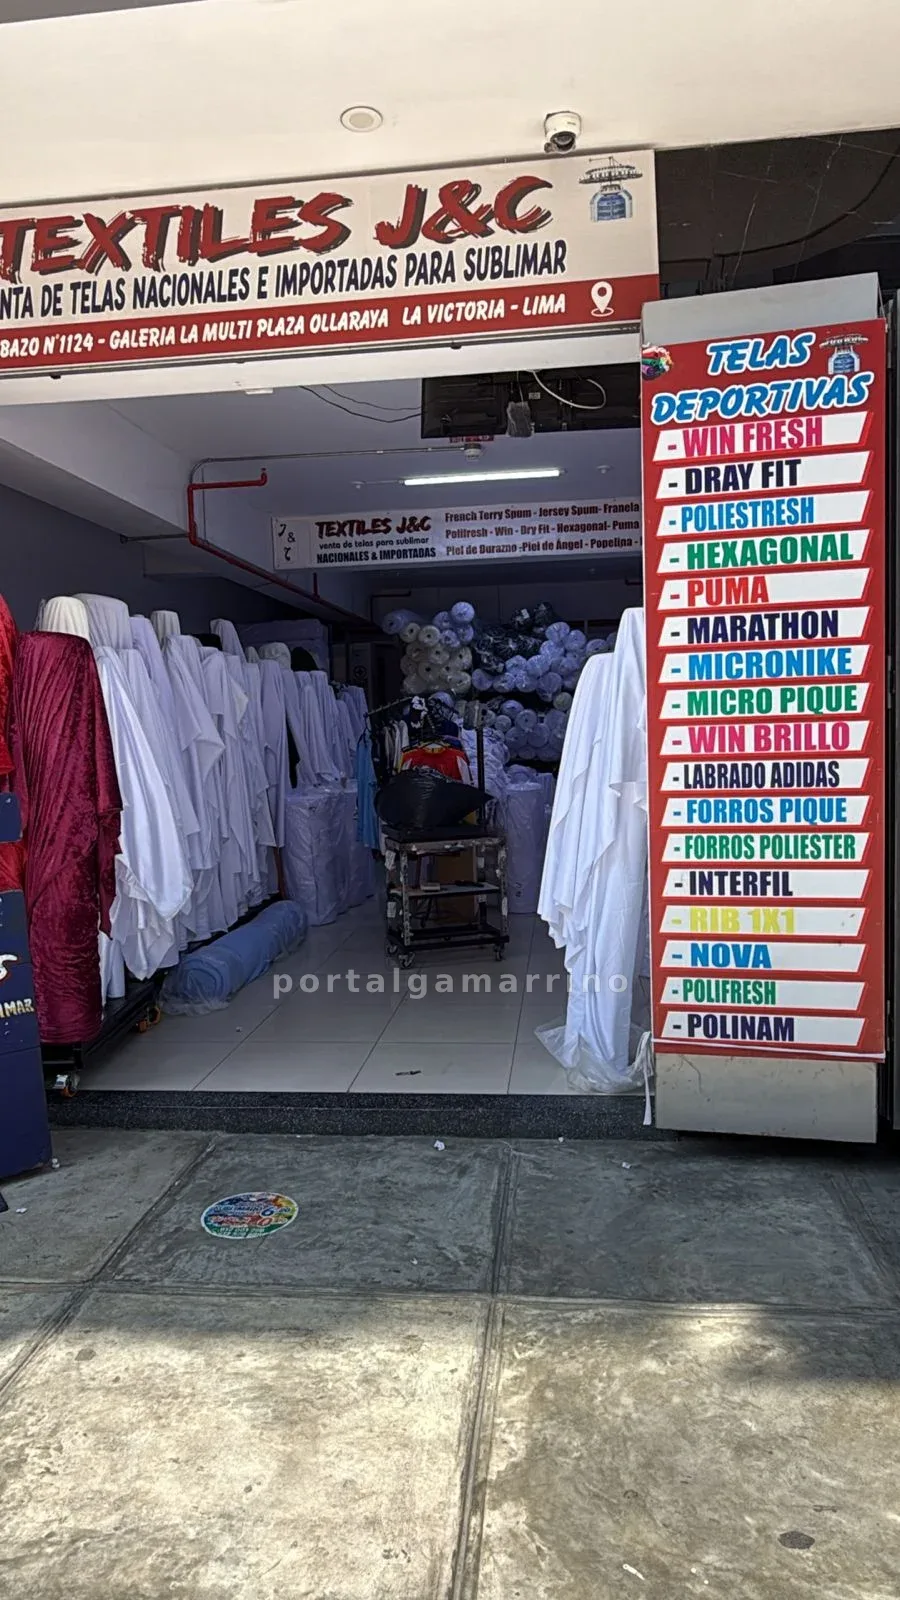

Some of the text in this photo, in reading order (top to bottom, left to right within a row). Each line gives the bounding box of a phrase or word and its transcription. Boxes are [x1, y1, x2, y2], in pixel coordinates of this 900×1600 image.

[0, 175, 553, 284] TEXTILES J&C
[41, 283, 63, 318] DE
[69, 277, 126, 315] TELAS
[132, 266, 251, 310] NACIONALES
[257, 265, 270, 300] E
[275, 254, 398, 298] IMPORTADAS
[404, 249, 456, 287] PARA
[463, 239, 567, 282] SUBLIMAR
[109, 326, 175, 350] GALERIA
[180, 324, 199, 344] LA
[202, 319, 252, 342] MULTI
[257, 315, 305, 338] PLAZA
[309, 308, 389, 332] OLLARAYA
[402, 306, 422, 326] LA
[426, 298, 505, 324] VICTORIA
[522, 293, 566, 316] LIMA
[707, 332, 815, 375] TELAS
[651, 372, 874, 425] DEPORTIVAS
[682, 425, 735, 458] WIN
[742, 416, 823, 452] FRESH
[685, 462, 754, 495] DRAY
[761, 458, 802, 489] FIT
[315, 516, 432, 539] TEXTILES J&C
[445, 511, 477, 522] French
[478, 510, 503, 520] Terry
[538, 506, 570, 517] Jersey
[494, 526, 513, 536] Win
[520, 525, 537, 536] Dry
[538, 523, 550, 534] Fit
[612, 520, 640, 530] Puma
[681, 496, 814, 533] POLIESTRESH
[317, 547, 436, 564] NACIONALES & IMPORTADAS
[319, 537, 429, 550] venta de telas para sublimar
[466, 545, 478, 555] de
[479, 544, 517, 554] Durazno
[541, 540, 554, 551] de
[687, 533, 854, 570] HEXAGONAL
[687, 575, 770, 607] PUMA
[687, 610, 839, 644] MARATHON
[688, 648, 852, 681] MICRONIKE
[687, 687, 773, 717] MICRO
[780, 685, 858, 715] PIQUE
[688, 725, 746, 753] WIN
[753, 721, 850, 752] BRILLO
[684, 762, 766, 789] LABRADO
[770, 761, 840, 789] ADIDAS
[687, 798, 773, 824] FORROS
[780, 797, 847, 825] PIQUE
[684, 835, 755, 860] FORROS
[759, 834, 856, 860] POLIESTER
[689, 871, 793, 897] INTERFIL
[689, 907, 740, 932] RIB
[747, 908, 795, 933] 1X1
[690, 943, 772, 969] NOVA
[682, 979, 776, 1005] POLIFRESH
[687, 1014, 795, 1042] POLINAM
